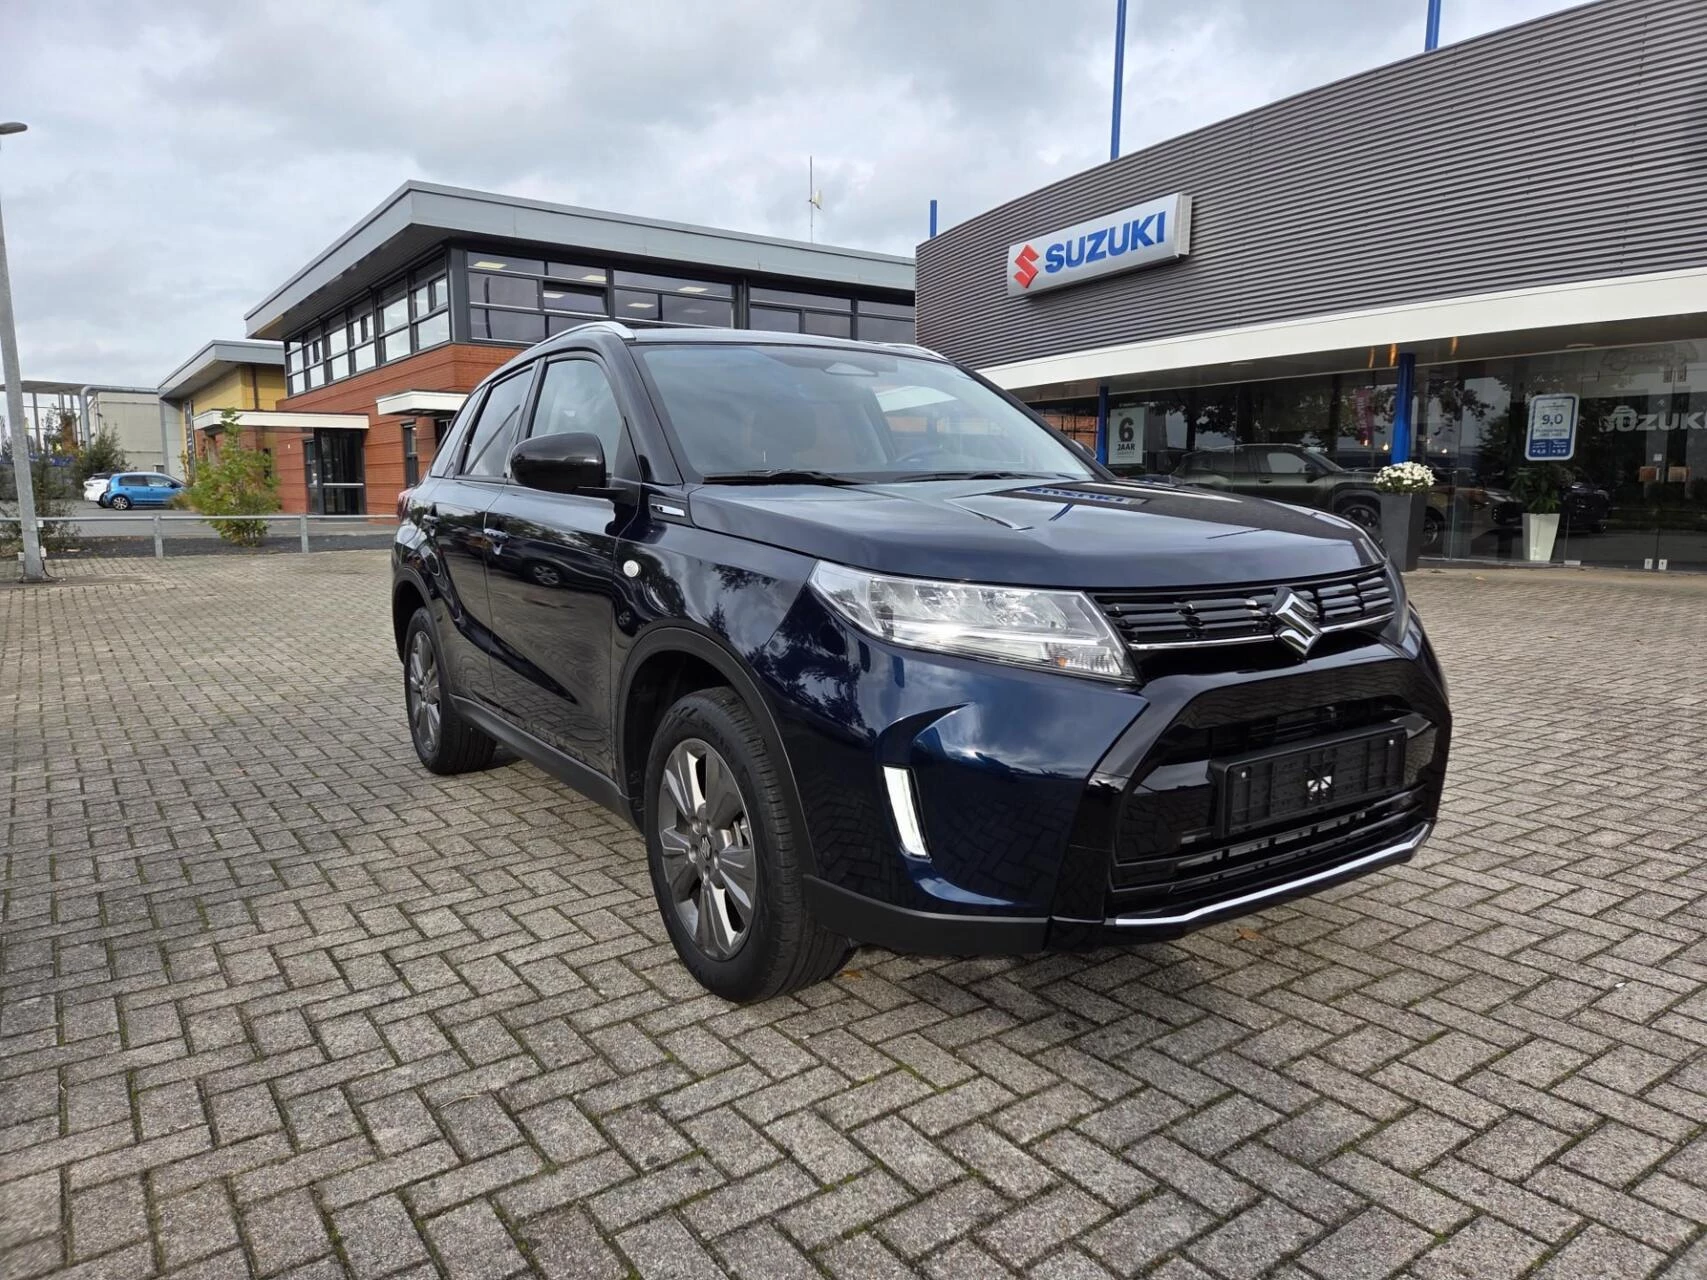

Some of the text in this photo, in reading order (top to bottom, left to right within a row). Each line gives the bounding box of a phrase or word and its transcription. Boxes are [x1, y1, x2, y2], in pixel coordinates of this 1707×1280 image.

[1045, 211, 1166, 273] SUZUKI
[1119, 417, 1134, 442] 6
[1117, 443, 1136, 451] JAAR
